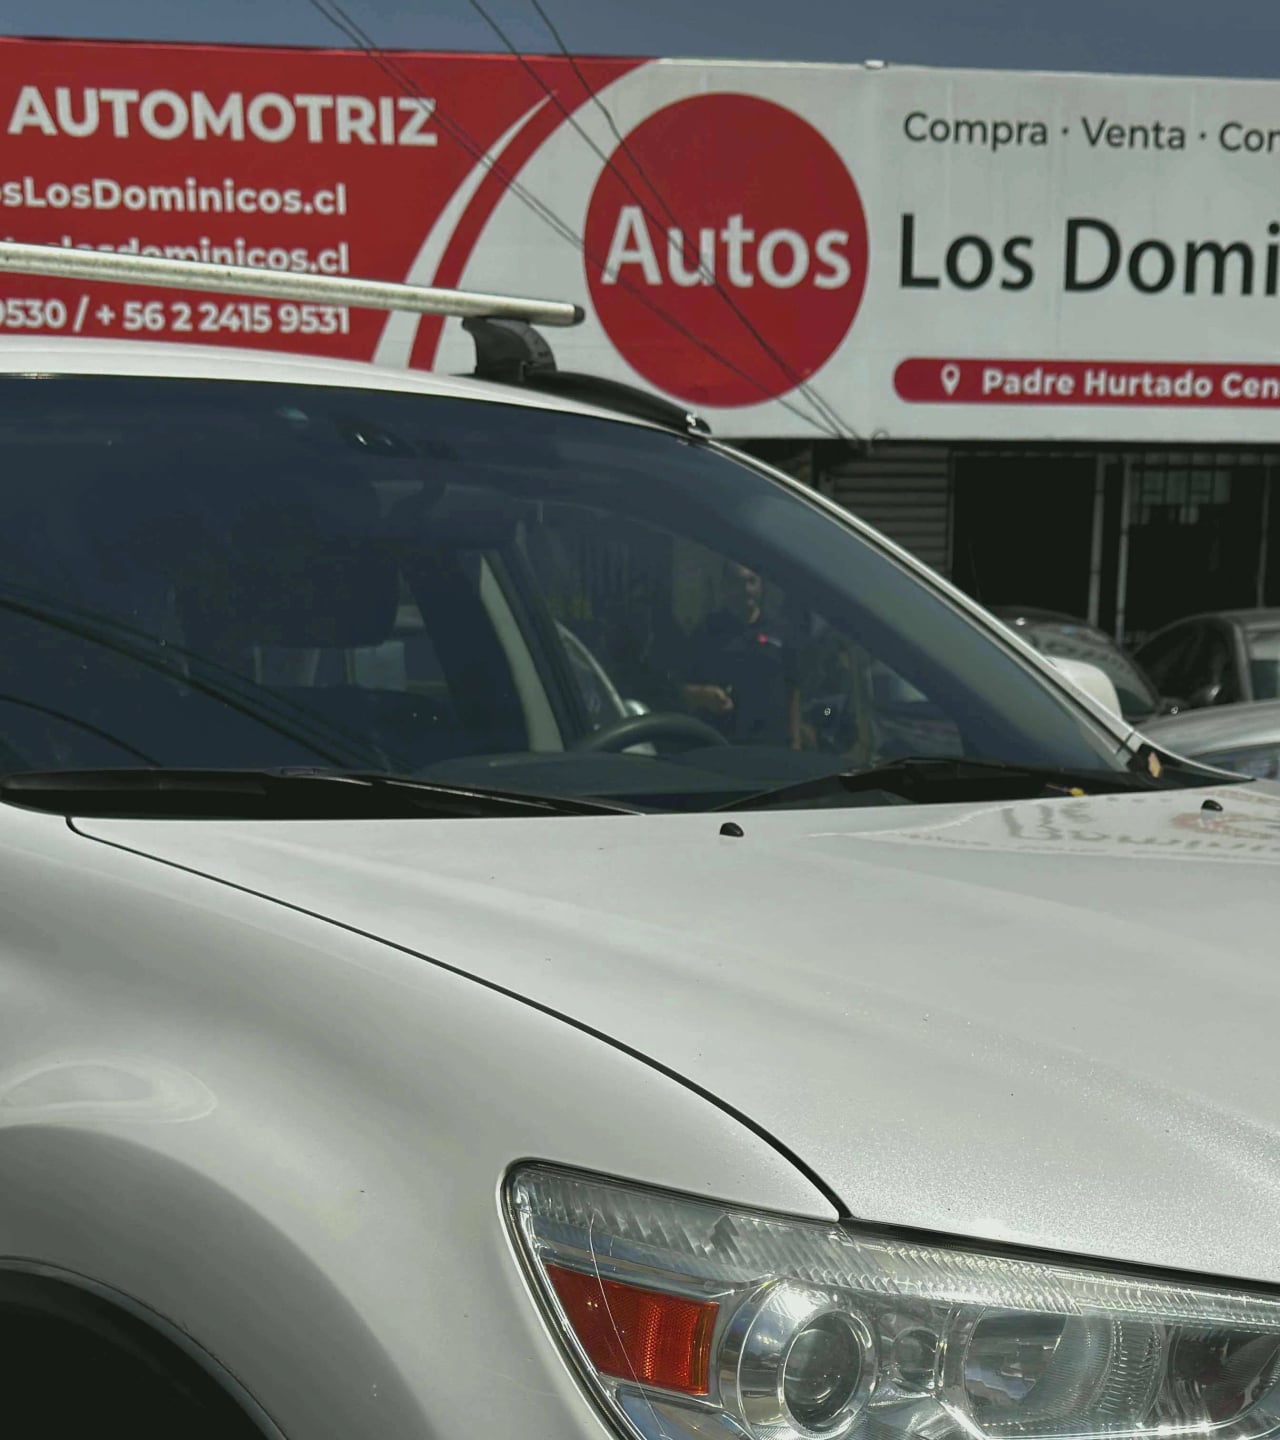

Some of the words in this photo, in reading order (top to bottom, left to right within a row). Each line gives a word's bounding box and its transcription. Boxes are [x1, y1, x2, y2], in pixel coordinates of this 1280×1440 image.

[7, 85, 438, 147] AUTOMOTRIZ
[903, 111, 1048, 152] Compra
[1081, 116, 1186, 150] Venta
[600, 204, 852, 290] Autos
[899, 212, 1035, 291] Los
[123, 300, 166, 331] 56
[170, 301, 193, 333] 2
[198, 303, 273, 333] 2415
[278, 304, 350, 335] 9531
[981, 367, 1075, 396] Padre
[1083, 369, 1212, 399] Hurtado
